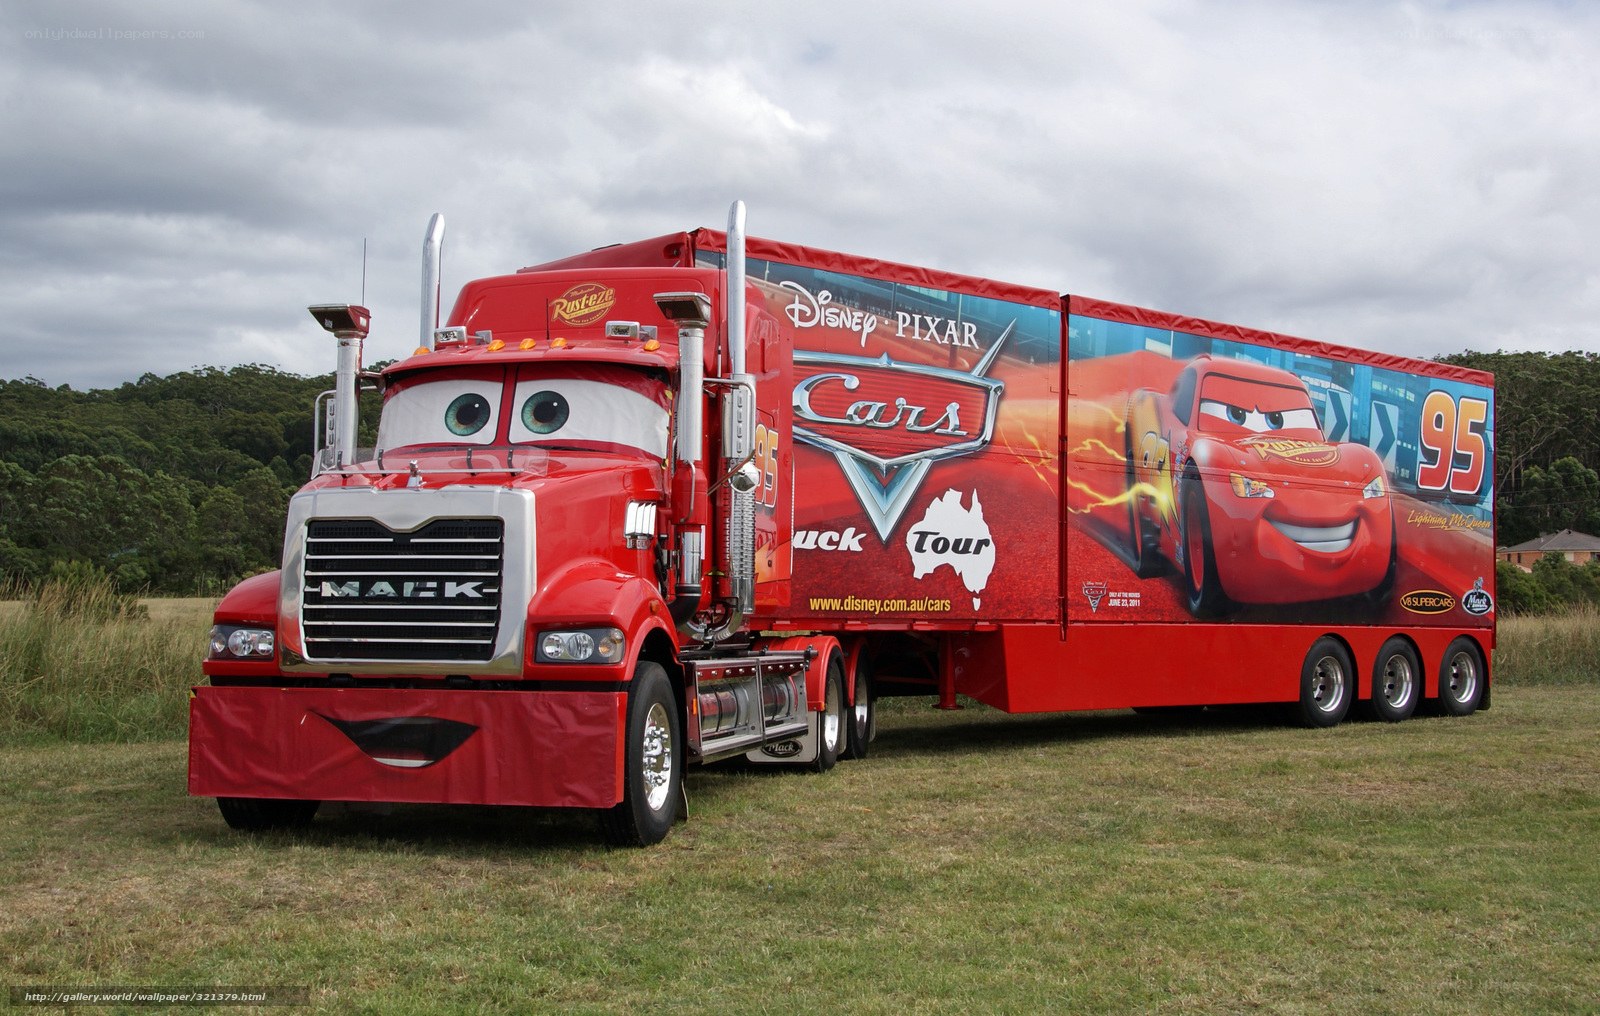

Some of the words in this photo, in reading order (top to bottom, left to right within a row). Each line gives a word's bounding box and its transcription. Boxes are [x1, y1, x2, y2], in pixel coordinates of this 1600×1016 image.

[779, 281, 877, 347] Disney
[896, 311, 979, 349] PIXAR
[792, 373, 968, 436] Cars
[1418, 390, 1488, 495] 95
[1407, 509, 1447, 528] Lightning
[1449, 513, 1491, 531] McQueen
[792, 527, 867, 552] uck
[912, 530, 990, 555] Tour
[321, 581, 484, 598] MACK
[809, 596, 951, 615] www.disney.com.au/cars
[1129, 599, 1141, 607] 2011
[1402, 596, 1412, 606] V8
[1412, 597, 1453, 607] SUPERCARS
[768, 743, 795, 752] Mack
